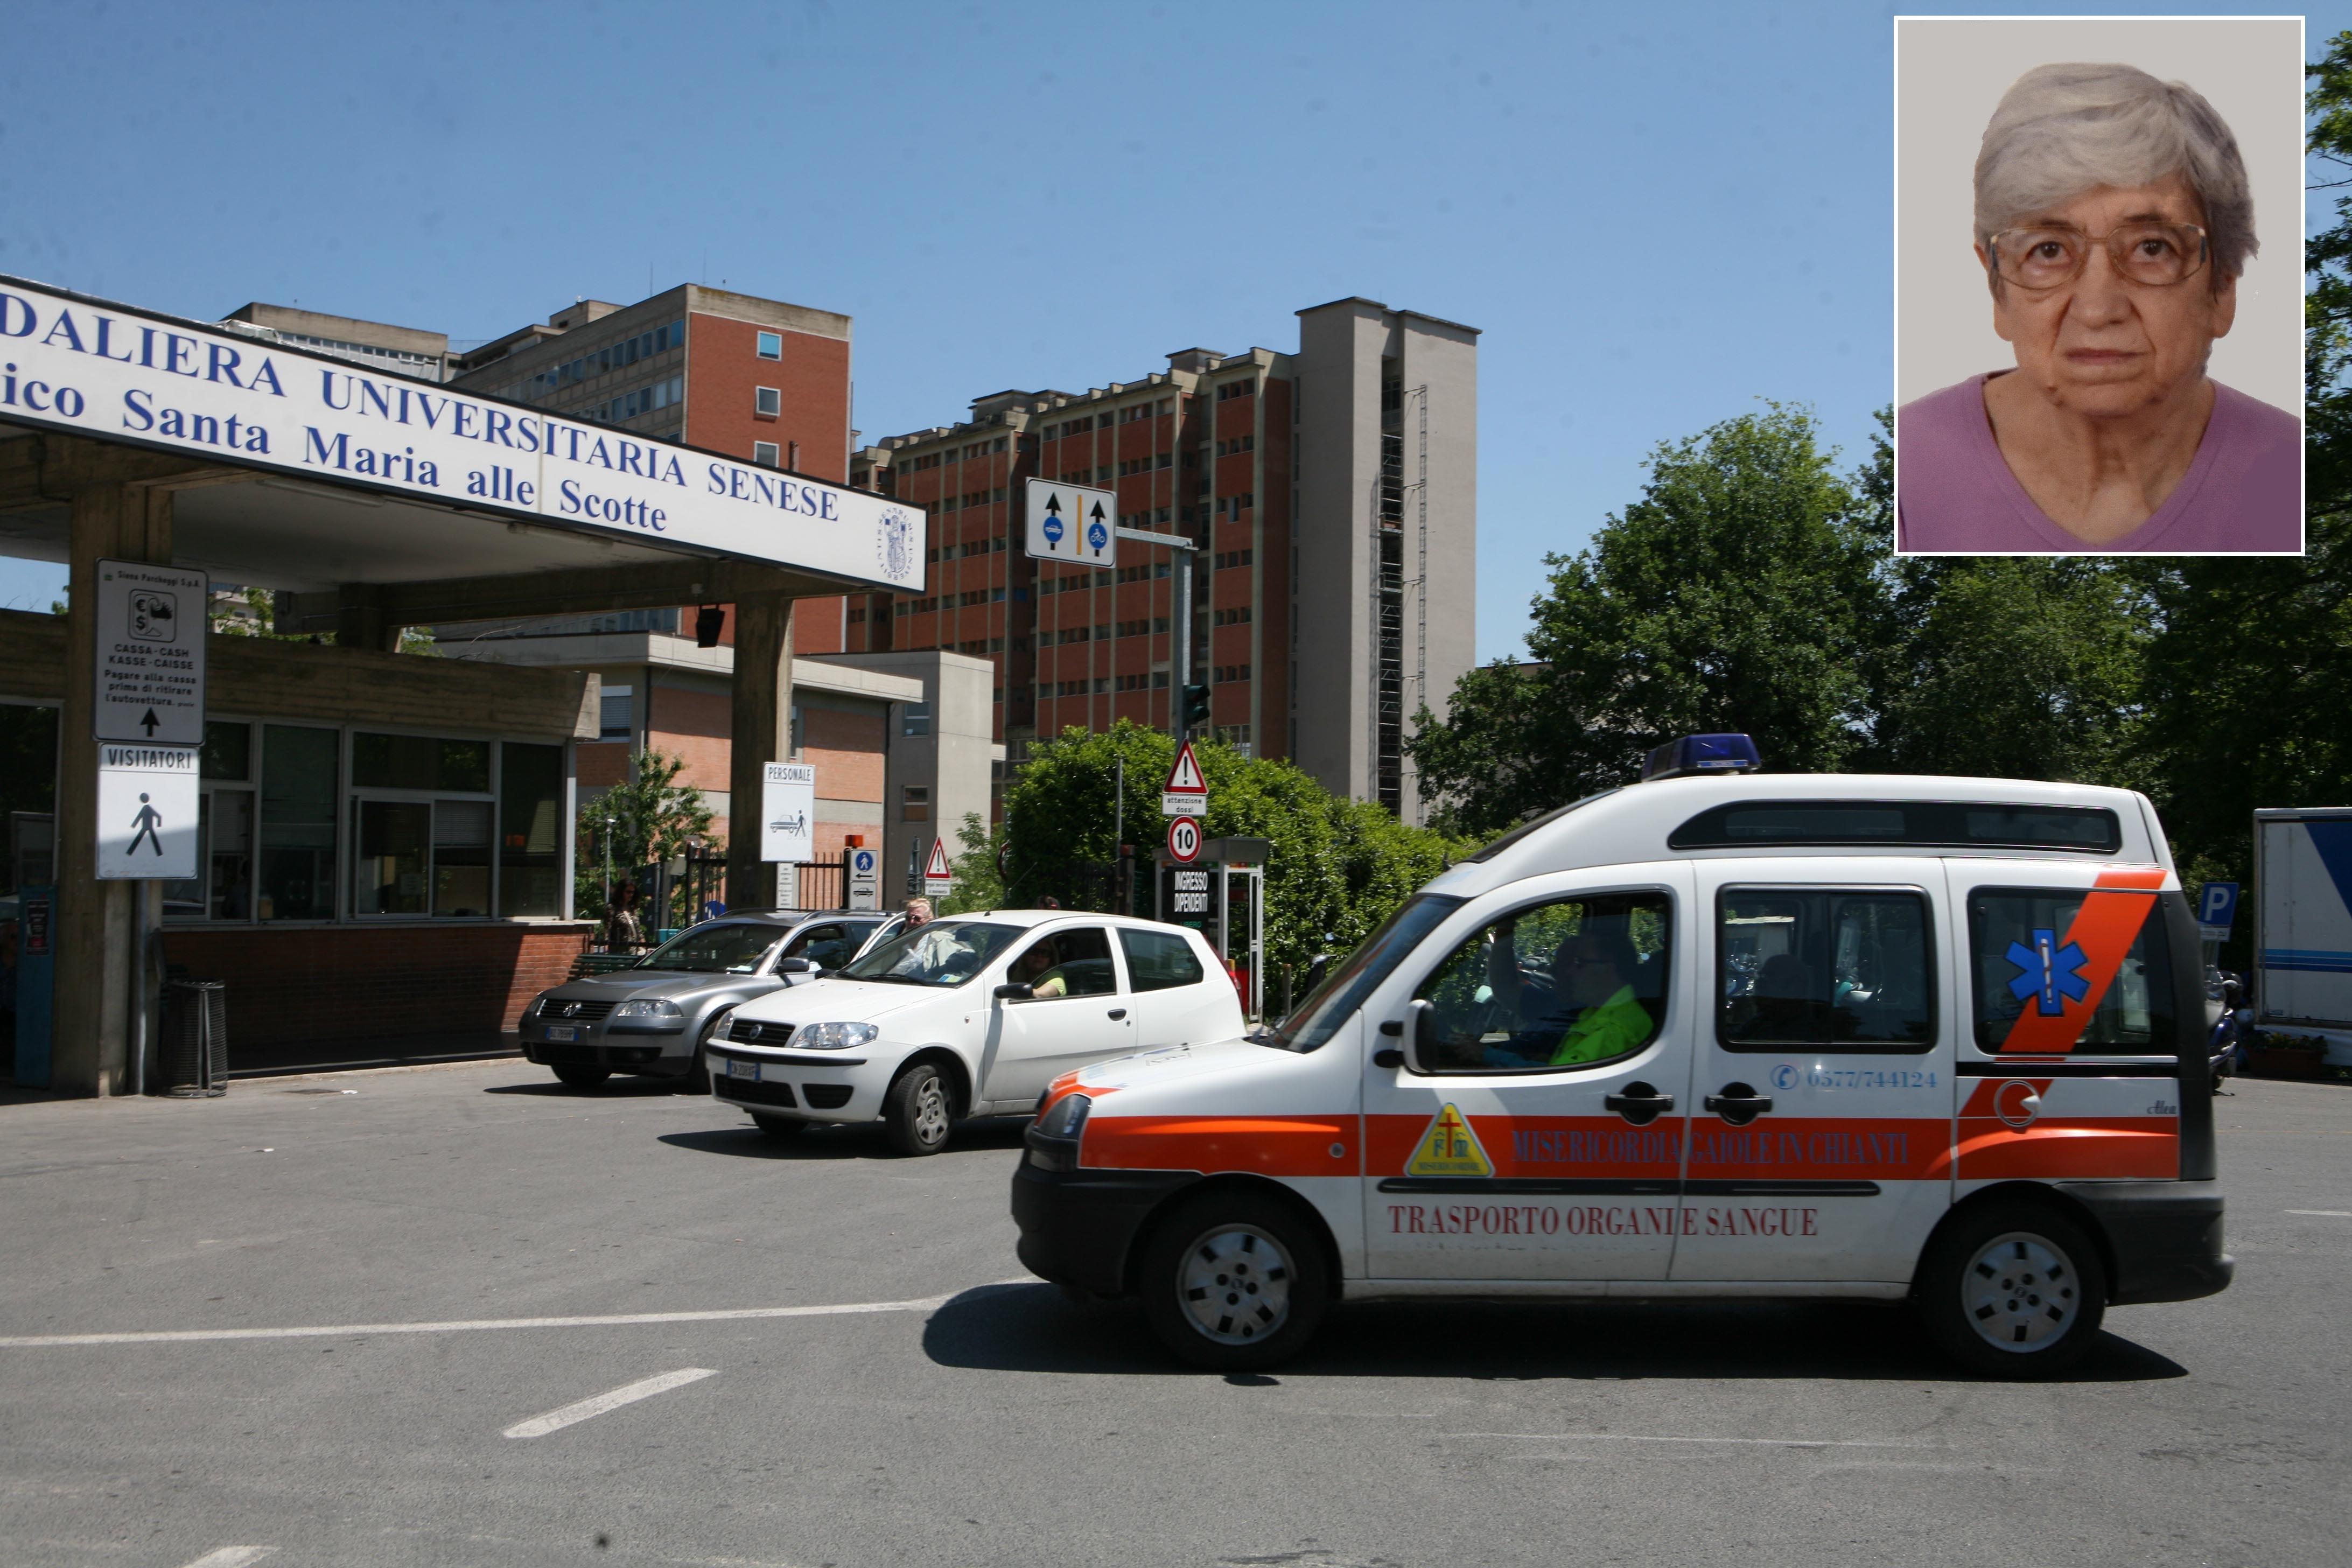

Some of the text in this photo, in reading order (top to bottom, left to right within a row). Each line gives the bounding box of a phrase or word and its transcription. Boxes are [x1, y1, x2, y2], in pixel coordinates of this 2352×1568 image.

[0, 291, 839, 522] DALIERA UNIVERSITARIA SENESE
[1, 362, 667, 531] ico Santa Maria alle Scotte
[117, 570, 138, 581] Siena
[104, 669, 140, 681] Pagare
[144, 674, 164, 682] alla
[108, 682, 192, 696] prima di ritirare
[108, 747, 192, 771] VISITATORI
[768, 767, 811, 782] PERSONALE
[1177, 829, 1193, 850] 10
[1174, 871, 1208, 891] INGRESSO
[1174, 892, 1208, 913] DIPENDENTI
[2205, 887, 2230, 921] P
[1807, 1070, 1937, 1089] 0577/744124
[1511, 1130, 1908, 1165] MISERICORDIA GAIOLE IN CHIANTI
[1388, 1205, 1818, 1237] TRASPORTO ORGANI E SANGUE
